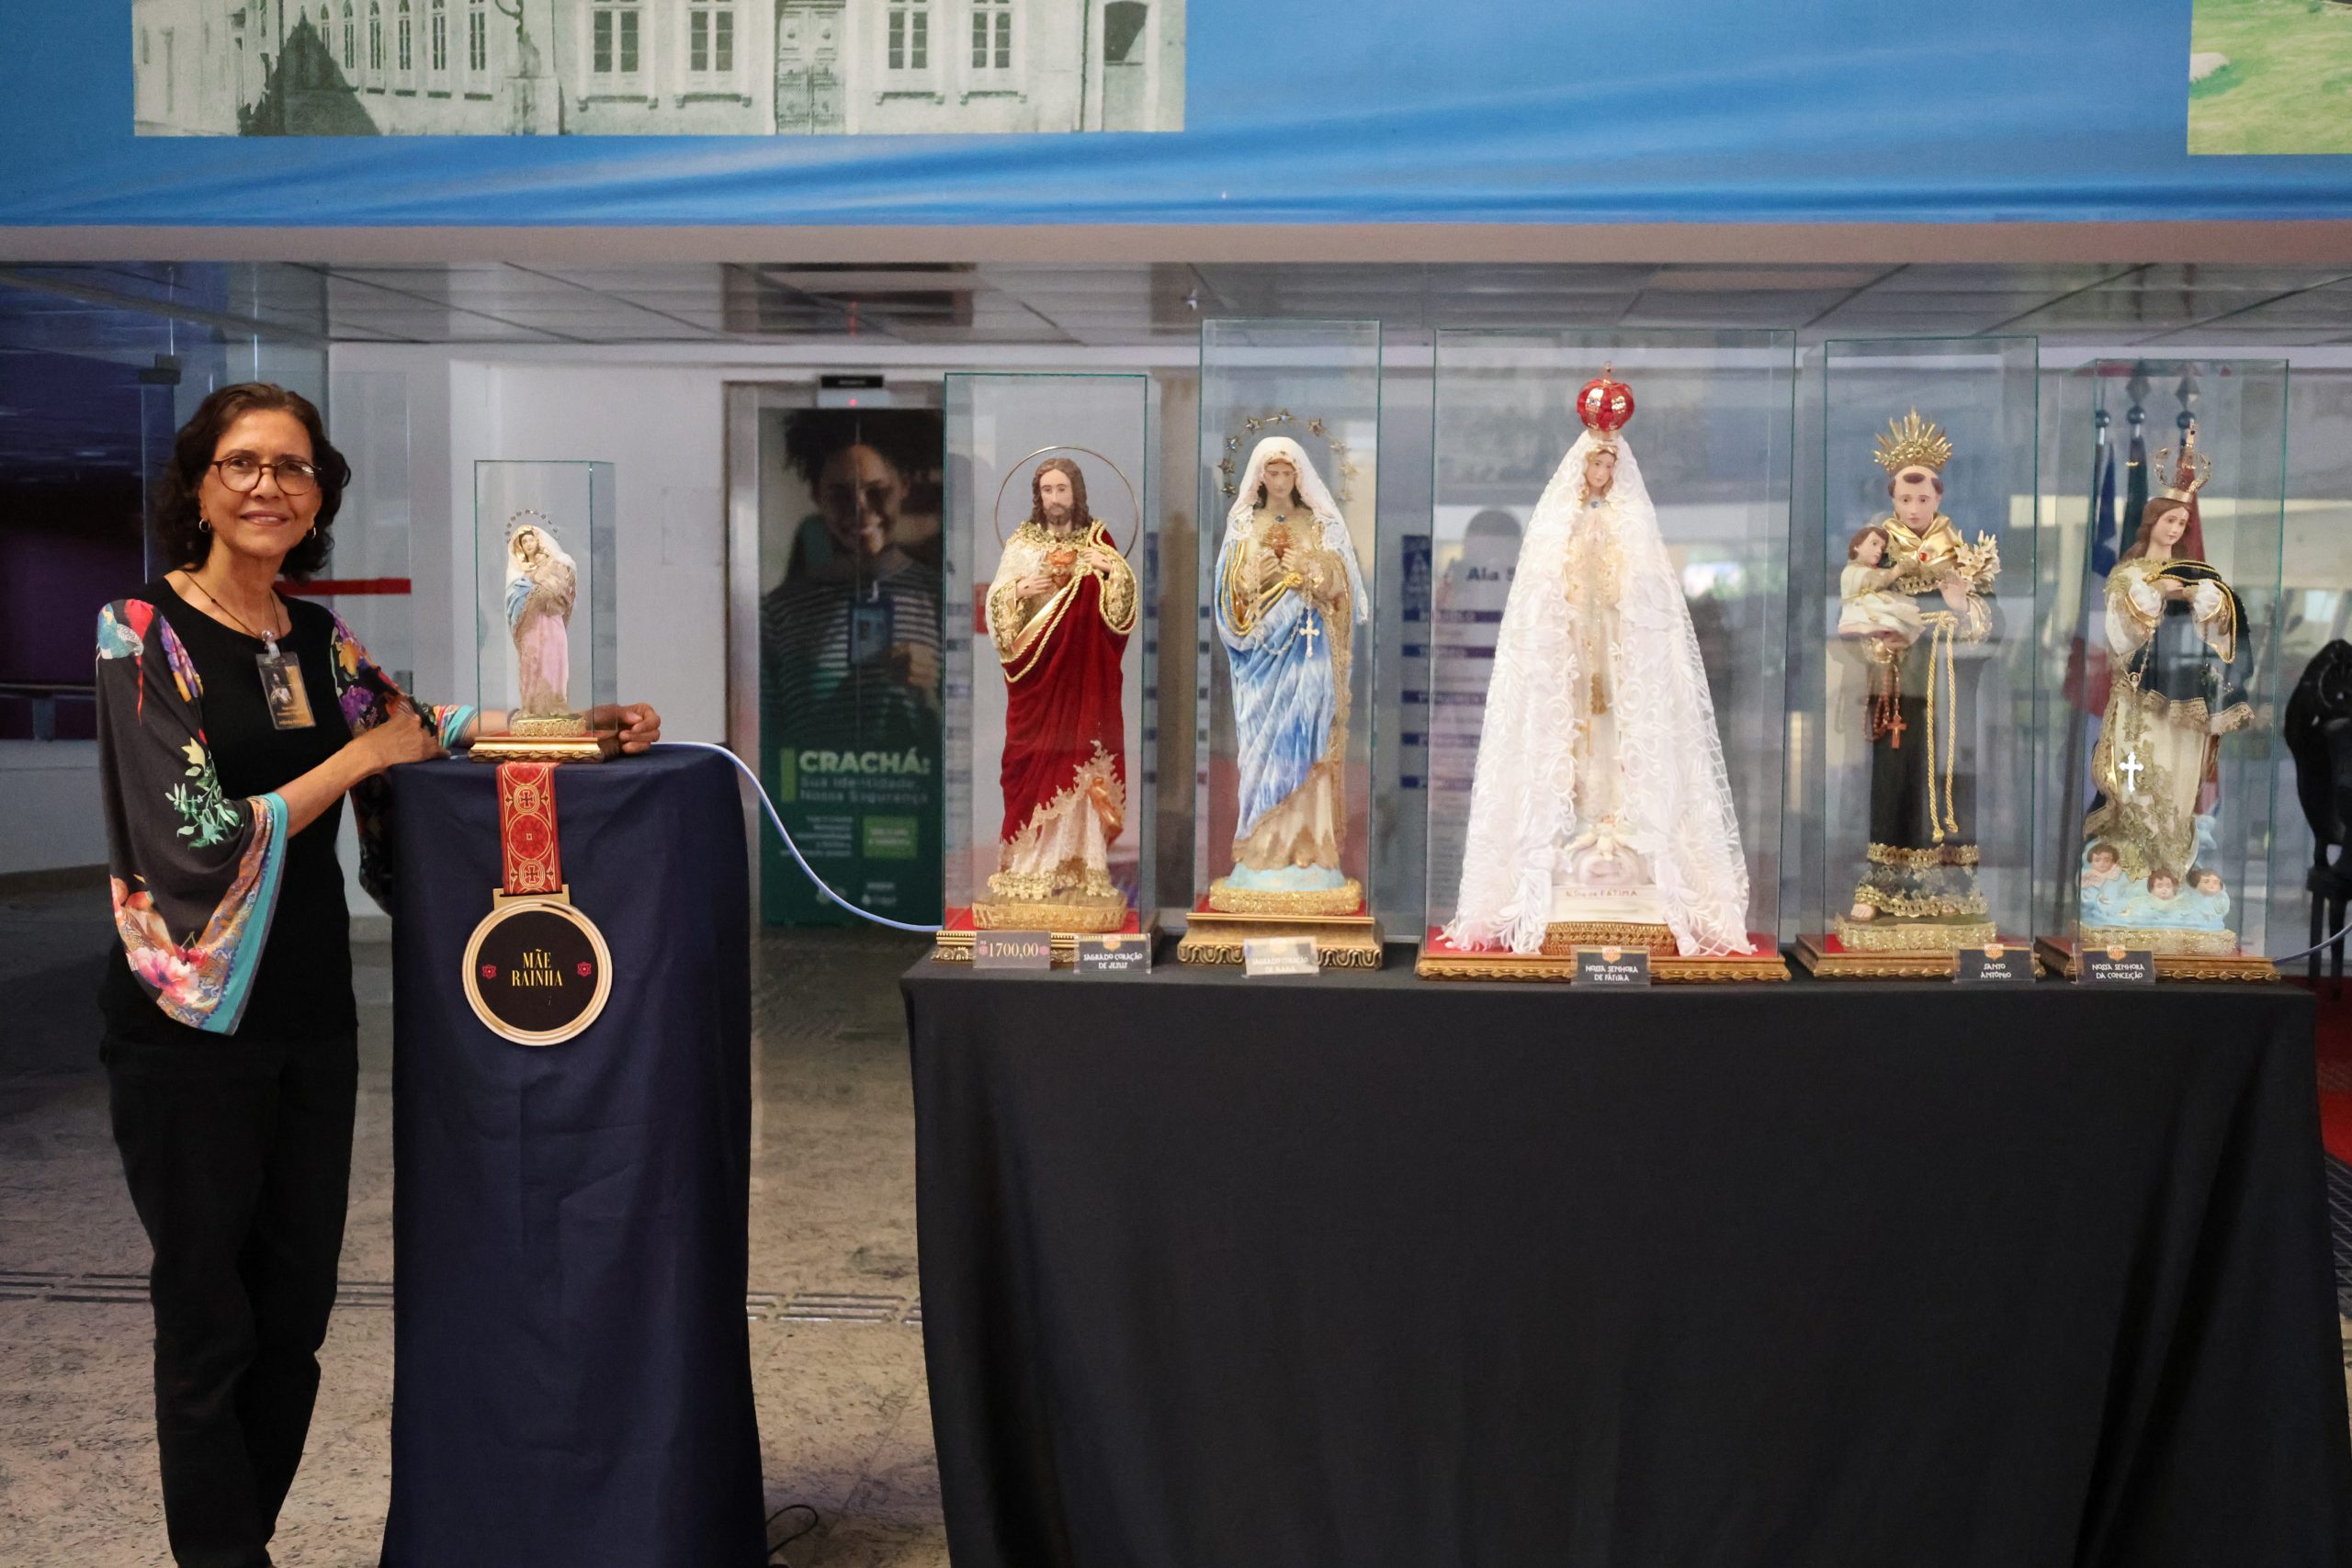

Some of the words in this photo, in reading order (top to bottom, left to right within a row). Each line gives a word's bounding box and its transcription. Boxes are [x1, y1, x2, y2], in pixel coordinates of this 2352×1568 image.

[1467, 567, 1498, 581] Ala
[798, 747, 932, 774] CRACHÁ:
[989, 942, 1039, 959] 1700,00
[523, 948, 551, 969] MÃE
[1083, 953, 1114, 962] SAGRADO
[1114, 952, 1143, 962] CORAÇÃO
[1098, 962, 1108, 970] DE
[1108, 962, 1128, 970] JESUS
[1585, 964, 1606, 974] NOSSA
[1607, 964, 1639, 975] SENHORA
[1984, 963, 2007, 971] SANTO
[2091, 963, 2113, 971] NOSSA
[2114, 963, 2145, 971] SENHORA
[512, 969, 563, 987] RAINHA
[1594, 974, 1603, 982] DE
[1604, 972, 1630, 982] FÁTIMA
[1980, 970, 2012, 979] ANTÔNIO
[2107, 971, 2143, 981] CONCEIÇÃO
